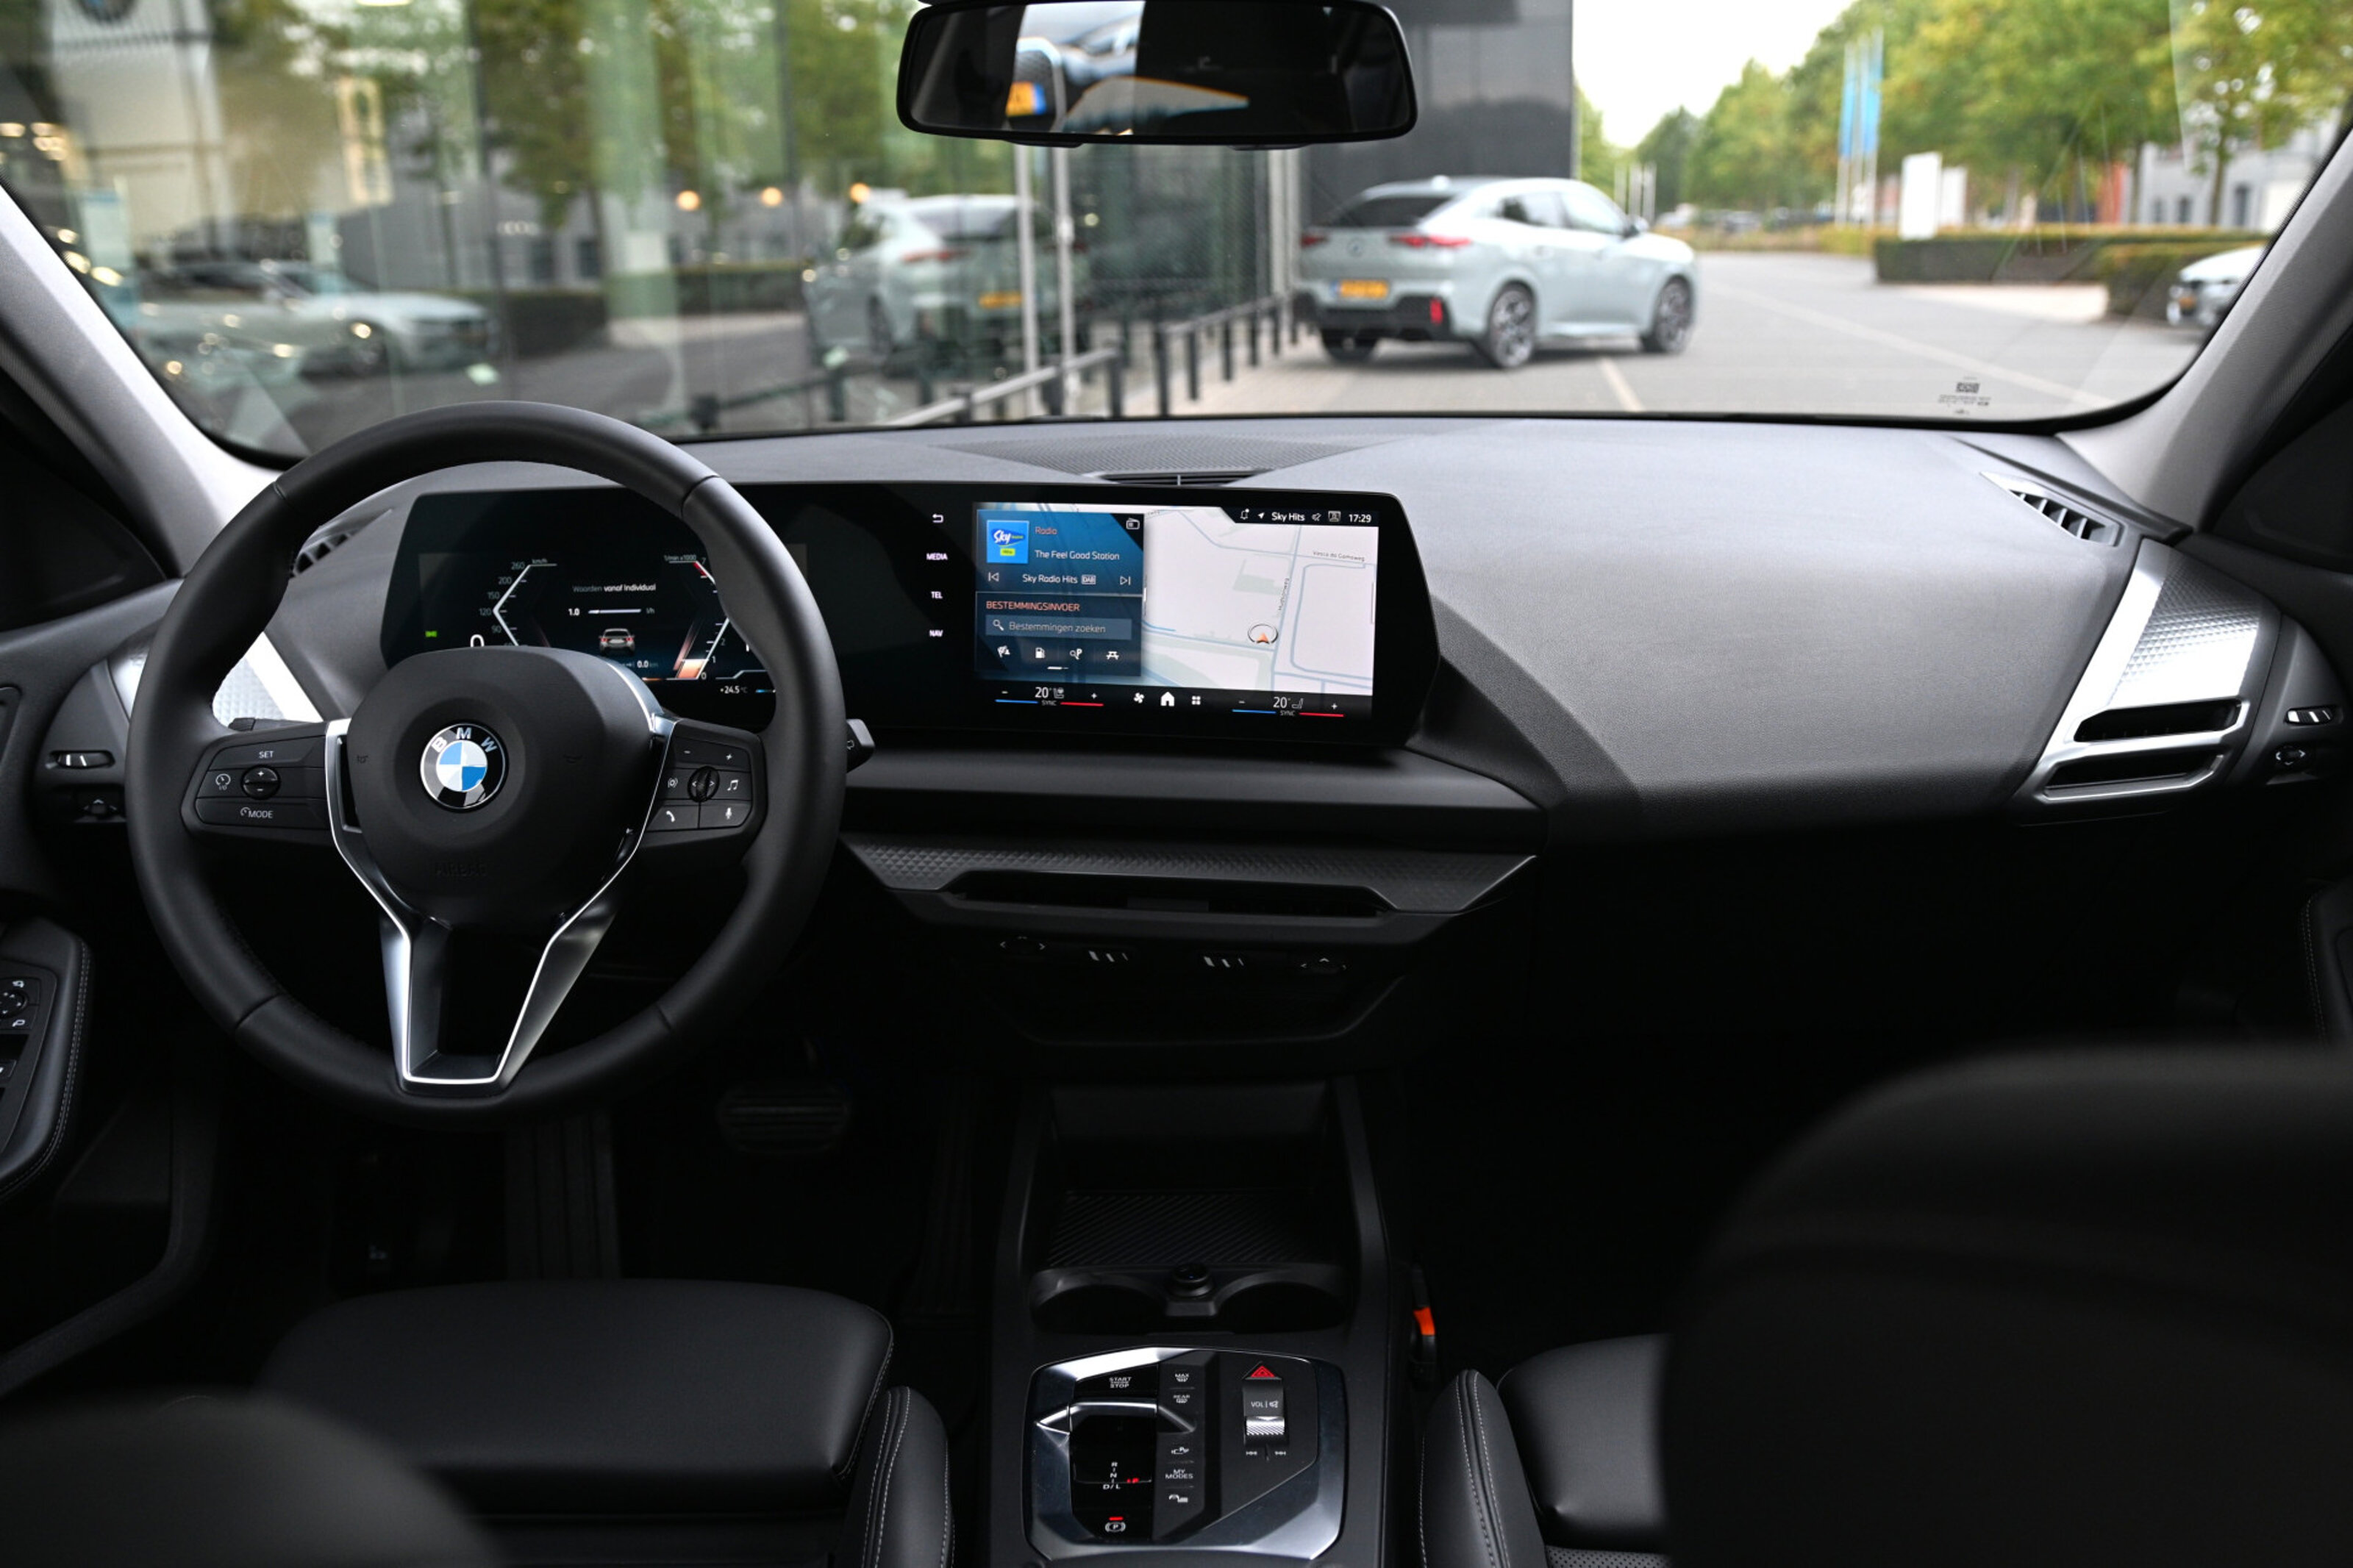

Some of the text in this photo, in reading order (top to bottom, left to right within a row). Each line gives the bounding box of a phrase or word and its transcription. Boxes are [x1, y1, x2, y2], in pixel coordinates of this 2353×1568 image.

[1271, 512, 1305, 521] Sky Hits
[1349, 514, 1372, 523] 17:29
[1035, 526, 1057, 535] Radio
[993, 529, 1011, 545] Sky
[1035, 550, 1120, 560] The Feel Good Station
[511, 562, 525, 570] 260
[499, 576, 512, 585] 200
[1022, 573, 1036, 584] Sky
[1038, 575, 1060, 584] Radio
[1062, 576, 1078, 584] Hits
[604, 584, 623, 592] vanaf
[487, 591, 500, 600] 150
[931, 591, 943, 599] TEL
[986, 601, 1080, 612] BESTEMMINGSINVOER
[479, 608, 492, 616] 120
[568, 608, 580, 616] 1.0
[491, 625, 501, 634] 90
[1009, 621, 1106, 634] Bestemmingen zoeken
[719, 638, 726, 646] 2
[637, 660, 649, 668] 0.0
[701, 672, 707, 680] 0
[720, 685, 740, 694] +24.5
[431, 726, 498, 753] BMW
[259, 751, 274, 759] SET
[249, 810, 274, 818] MODE
